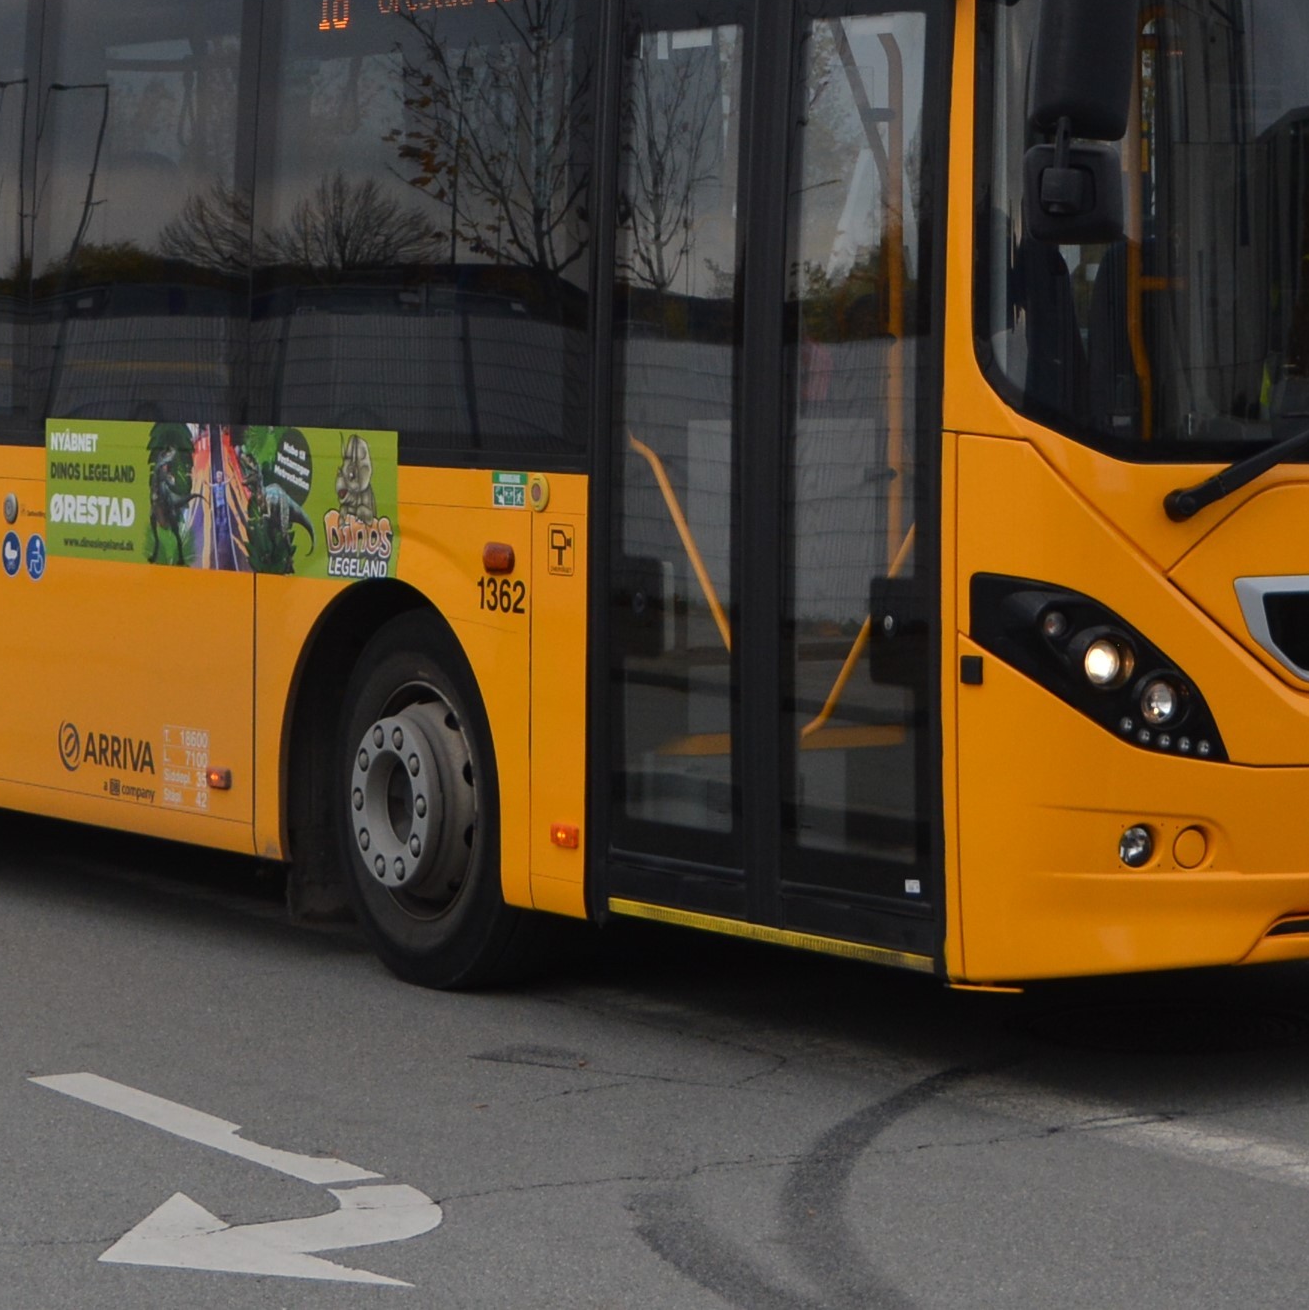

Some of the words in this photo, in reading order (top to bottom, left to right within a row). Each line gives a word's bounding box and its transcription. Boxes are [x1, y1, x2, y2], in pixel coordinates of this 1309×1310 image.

[50, 428, 99, 452] NYÅBNET
[51, 461, 81, 481] DINOS
[83, 463, 135, 483] LEGELAND
[49, 493, 135, 527] ØRESTAD
[328, 557, 387, 578] LEGELAND
[477, 576, 526, 614] 1362
[179, 729, 208, 749] 18600
[83, 731, 155, 775] ARRIVA
[185, 750, 208, 769] 7100
[121, 784, 156, 803] company
